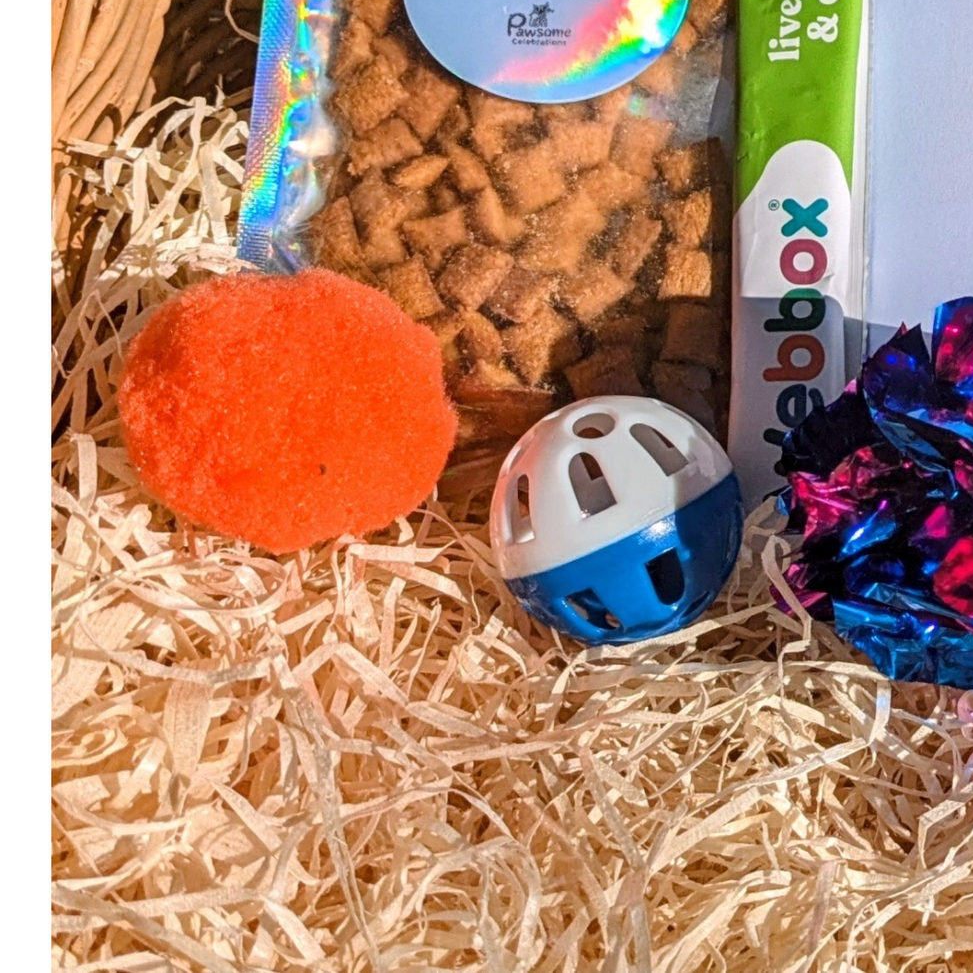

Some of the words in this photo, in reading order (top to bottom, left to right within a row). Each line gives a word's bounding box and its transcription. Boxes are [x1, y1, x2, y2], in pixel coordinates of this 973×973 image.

[507, 12, 572, 37] Pawsome
[806, 12, 840, 44] &
[762, 197, 829, 502] ebbox
